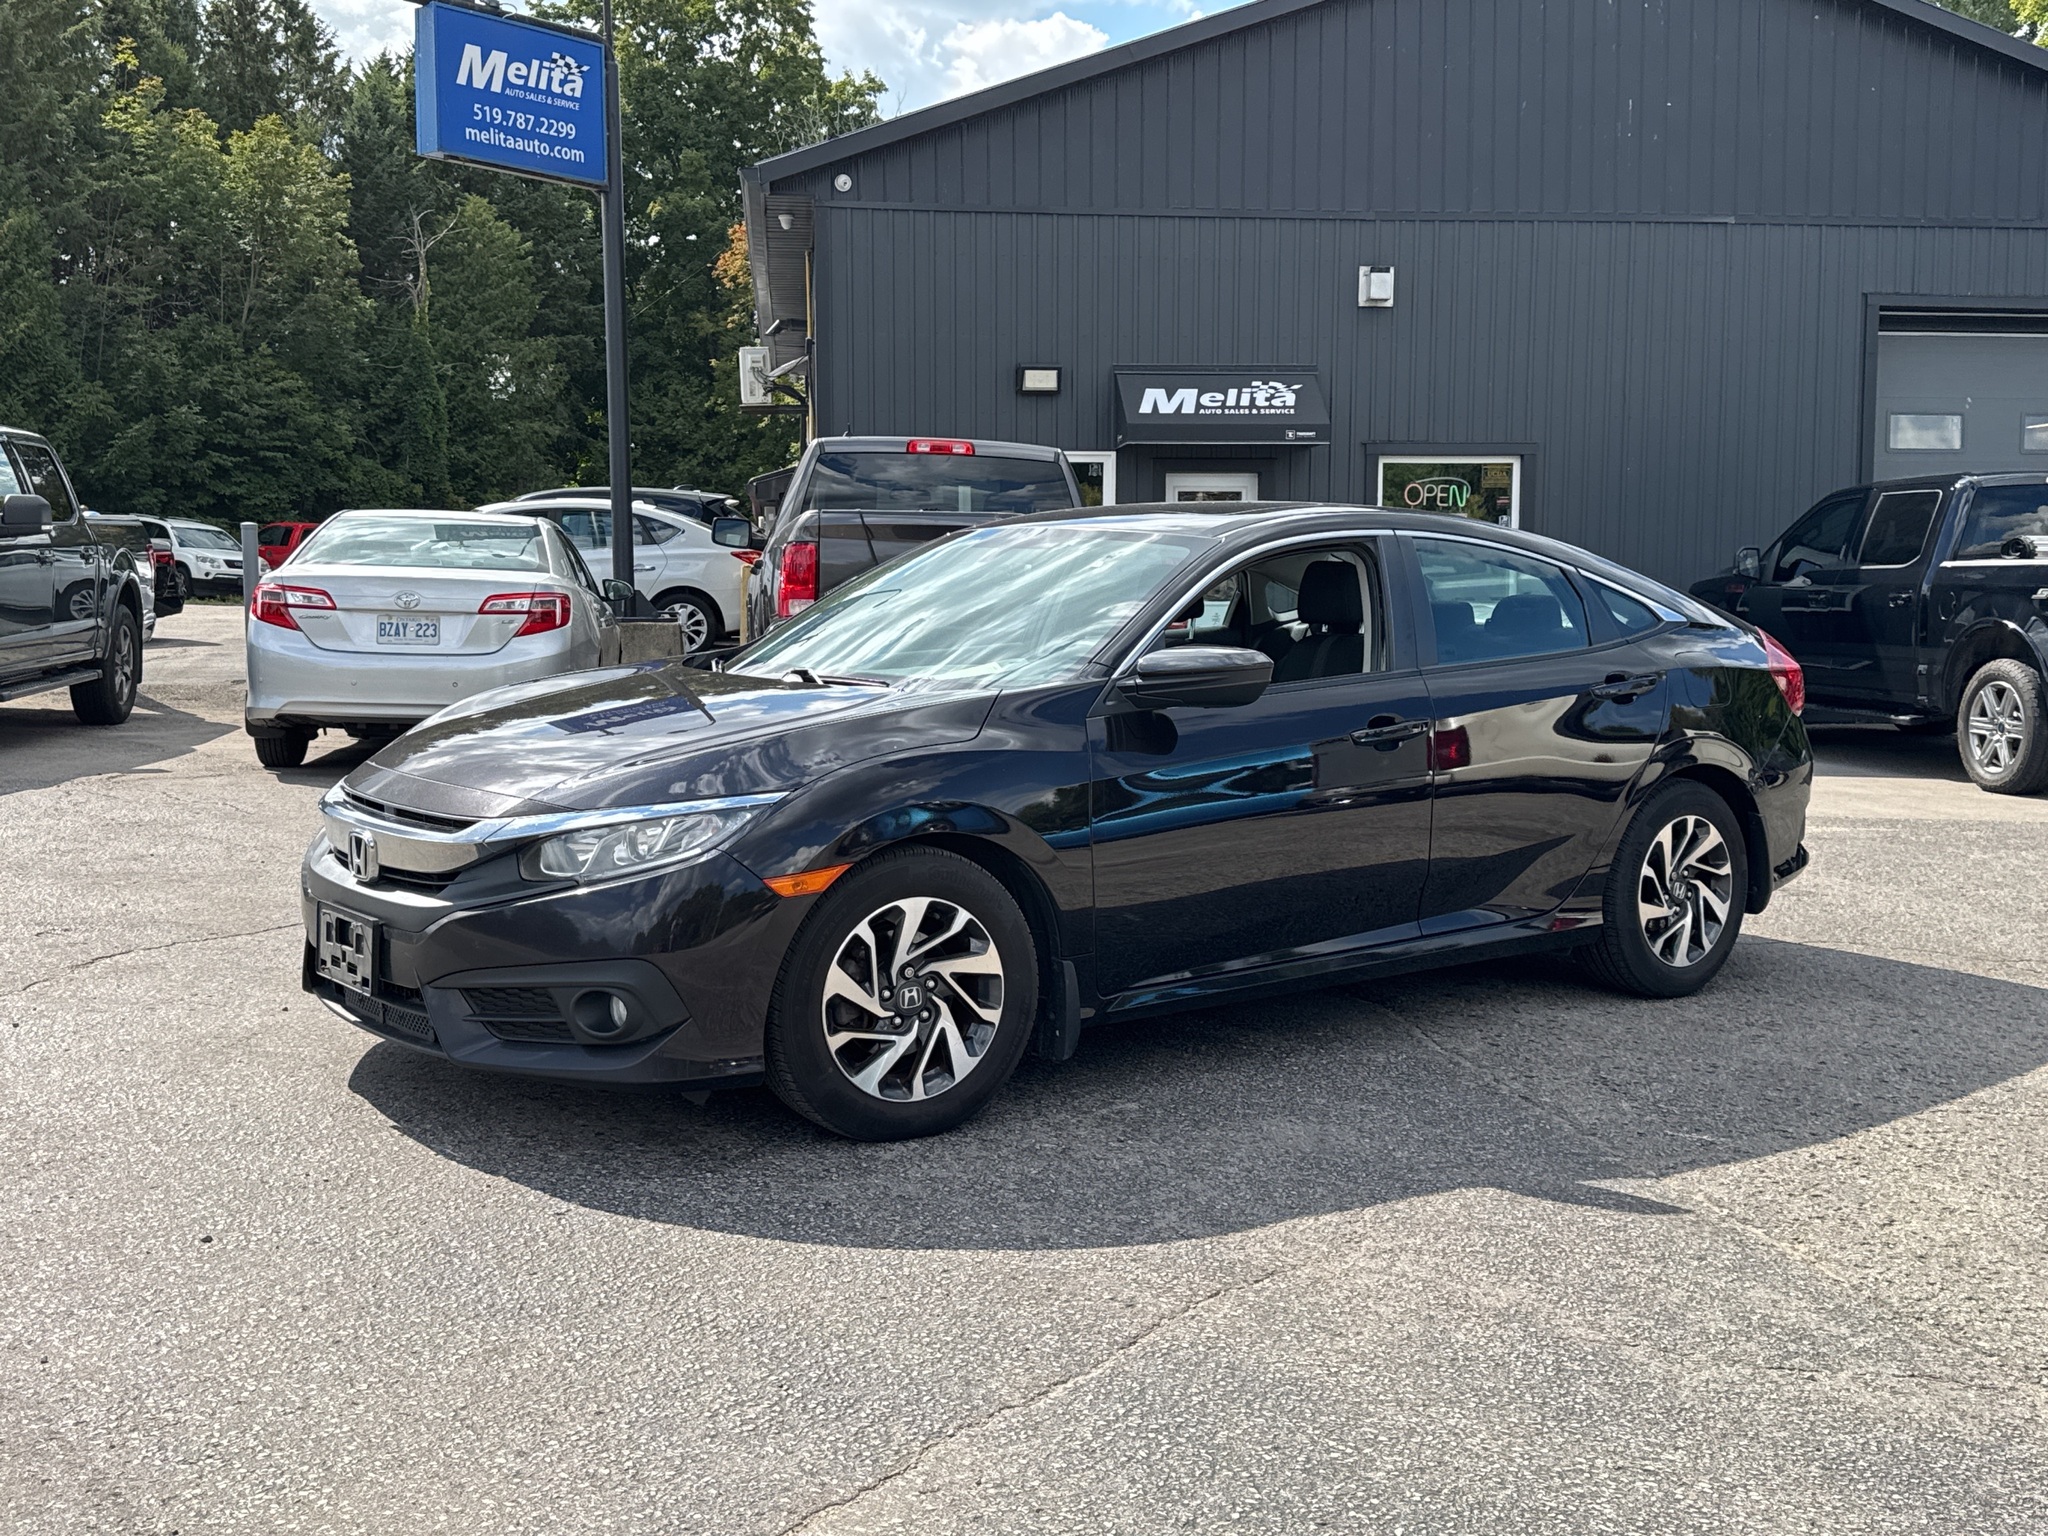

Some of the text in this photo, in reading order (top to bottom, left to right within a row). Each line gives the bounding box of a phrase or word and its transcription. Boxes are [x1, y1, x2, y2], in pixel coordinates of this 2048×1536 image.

[456, 43, 584, 99] Melita
[504, 87, 580, 111] AUTO SALES & SERVICE
[473, 103, 577, 140] 519.787.2299
[465, 126, 585, 163] melitaauto.com
[1138, 387, 1297, 414] Melita
[1404, 483, 1467, 507] OPEN
[379, 622, 438, 638] BZAY 223
